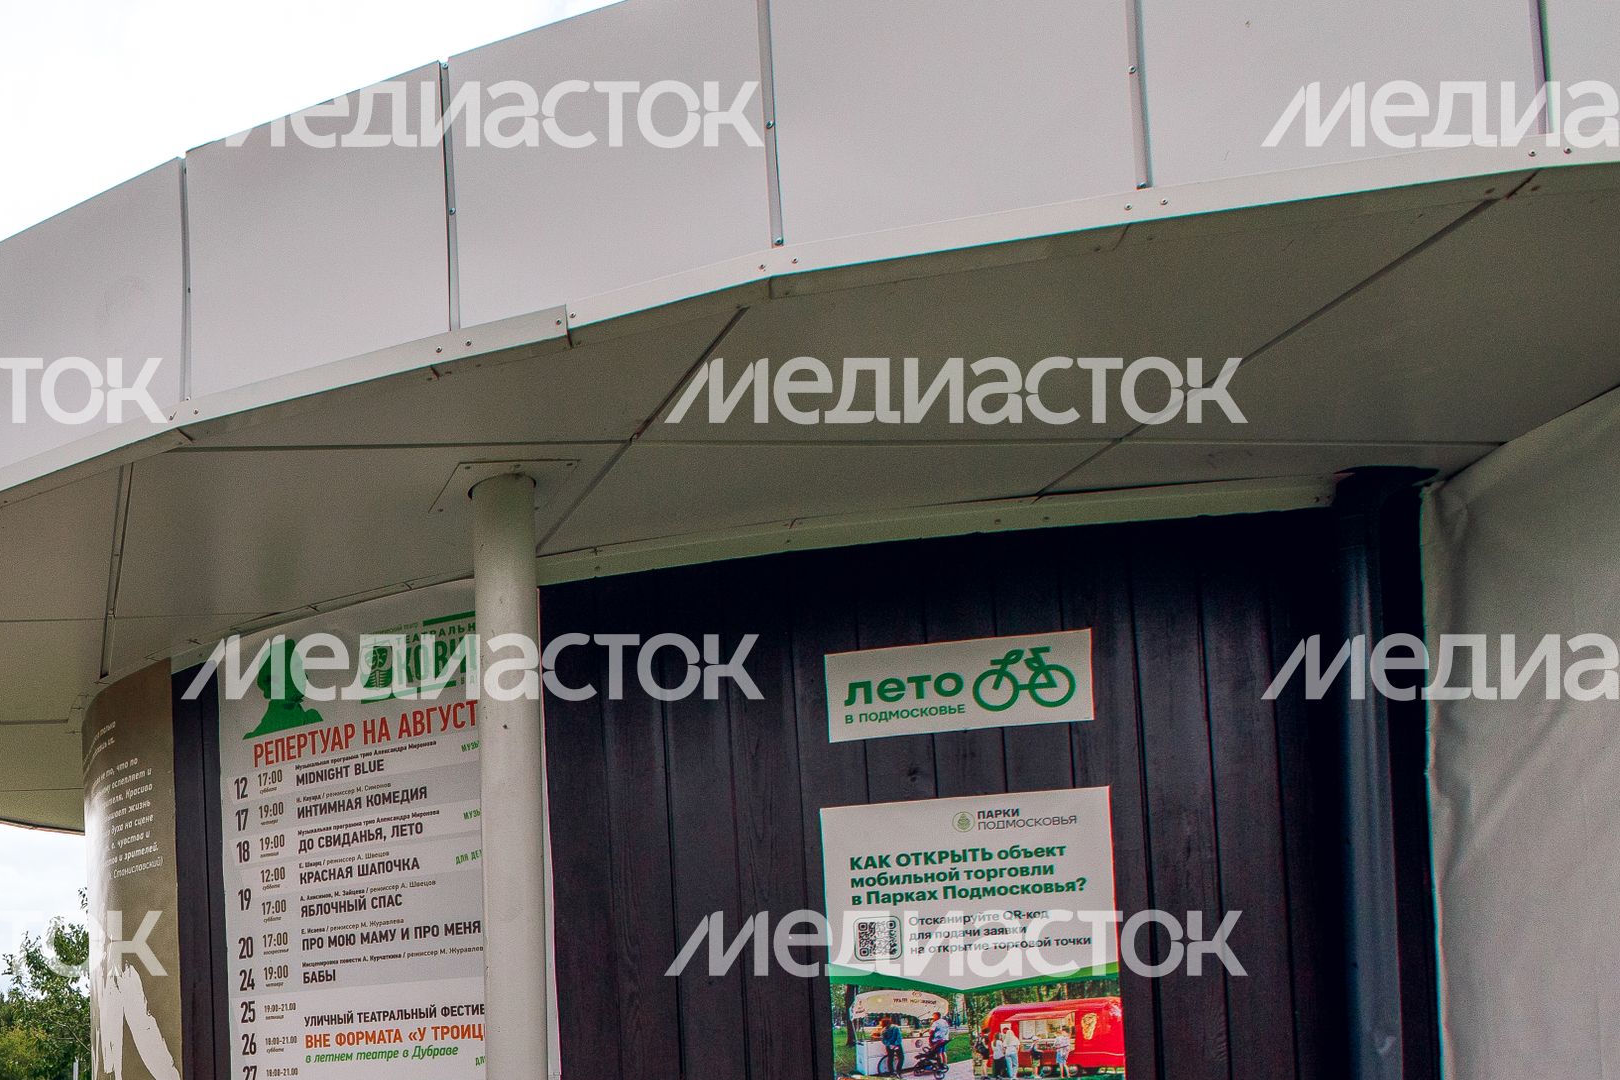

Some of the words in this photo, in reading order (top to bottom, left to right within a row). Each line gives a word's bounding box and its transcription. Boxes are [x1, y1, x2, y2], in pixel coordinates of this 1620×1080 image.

[843, 672, 965, 707] лето
[253, 723, 356, 768] РЕПЕРТУАР
[363, 716, 391, 745] НА
[398, 700, 478, 739] АВГУСТ
[258, 769, 283, 786] 17:00
[296, 765, 350, 786] MIDNIGHT
[354, 759, 385, 776] BLUE
[234, 776, 248, 800] 12
[259, 802, 284, 819] 19:00
[297, 796, 362, 819] ИНТИМНАЯ
[366, 786, 427, 807] КОМЕДИЯ
[977, 808, 1020, 820] ПАРКИ
[235, 808, 249, 831] 17
[977, 815, 1078, 831] ПОДМОСКОВЬЯ
[298, 839, 314, 854] ДО
[318, 827, 387, 851] СВИДАНЬЯ,
[390, 822, 424, 839] ЛЕТО
[236, 840, 250, 863] 18
[850, 855, 892, 871] КАК
[895, 847, 994, 867] ОТКРЫТЬ
[997, 844, 1067, 860] объект
[260, 866, 286, 883] 12:00
[299, 867, 353, 885] КРАСНАЯ
[357, 857, 420, 878] ШАПОЧКА
[851, 867, 960, 889] мобильной
[964, 864, 1054, 883] торговли
[238, 888, 252, 911] 19
[852, 895, 862, 906] в
[866, 885, 938, 906] Парках
[942, 877, 1087, 901] Подмосковья?
[300, 896, 367, 918] ЯБЛОЧНЫЙ
[371, 893, 403, 909] СПАС
[909, 912, 999, 927] Отсканируйте
[1003, 908, 1049, 921] QR-код
[301, 937, 324, 952] ПРО
[328, 933, 356, 949] МОЮ
[360, 929, 396, 946] МАМУ
[401, 927, 410, 941] И
[414, 924, 440, 939] ПРО
[444, 920, 482, 936] МЕНЯ
[910, 930, 931, 943] для
[935, 927, 981, 940] подачи
[983, 926, 1027, 937] заявки
[910, 946, 925, 955] на
[928, 941, 989, 955] открытие
[993, 937, 1051, 951] торговой
[1054, 935, 1091, 947] точки
[238, 936, 253, 959] 20
[239, 968, 255, 992] 24
[303, 969, 336, 984] БАБЫ
[240, 1000, 255, 1024] 25
[304, 1011, 354, 1027] УЛИЧНЫЙ
[357, 1005, 437, 1023] ТЕАТРАЛЬНЫЙ
[305, 1033, 330, 1049] ВНЕ
[335, 1028, 403, 1046] ФОРМАТА
[408, 1026, 427, 1042] «У
[431, 1024, 486, 1043] ТРОИЦ
[314, 1051, 353, 1063] летнем
[356, 1049, 399, 1061] театре
[403, 1049, 409, 1058] в
[411, 1045, 459, 1059] Дубраве
